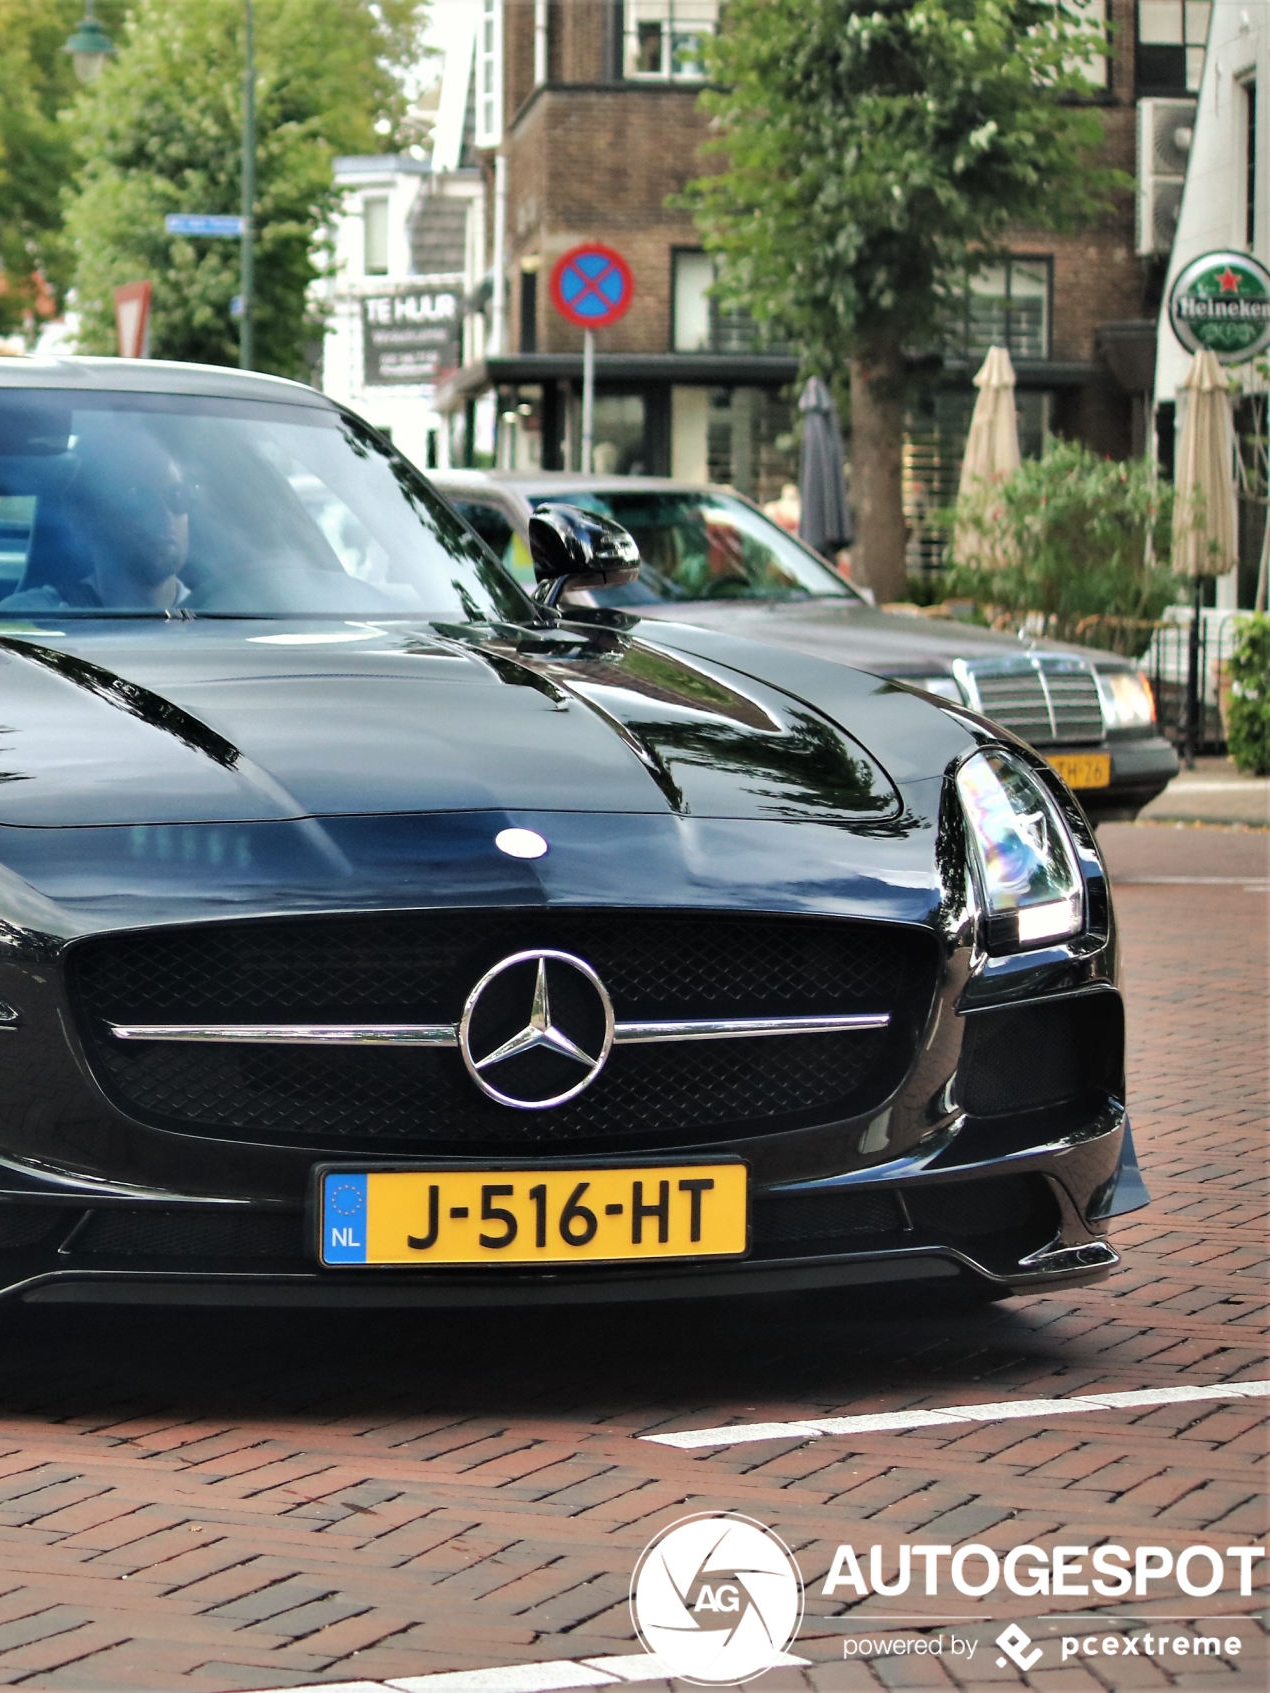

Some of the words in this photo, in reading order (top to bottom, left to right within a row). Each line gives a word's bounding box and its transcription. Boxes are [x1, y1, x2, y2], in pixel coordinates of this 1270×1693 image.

[365, 297, 392, 324] TE
[394, 293, 456, 322] HUUR
[1180, 297, 1270, 317] Heineken
[407, 1178, 715, 1250] J-516-HT
[331, 1227, 361, 1247] NL
